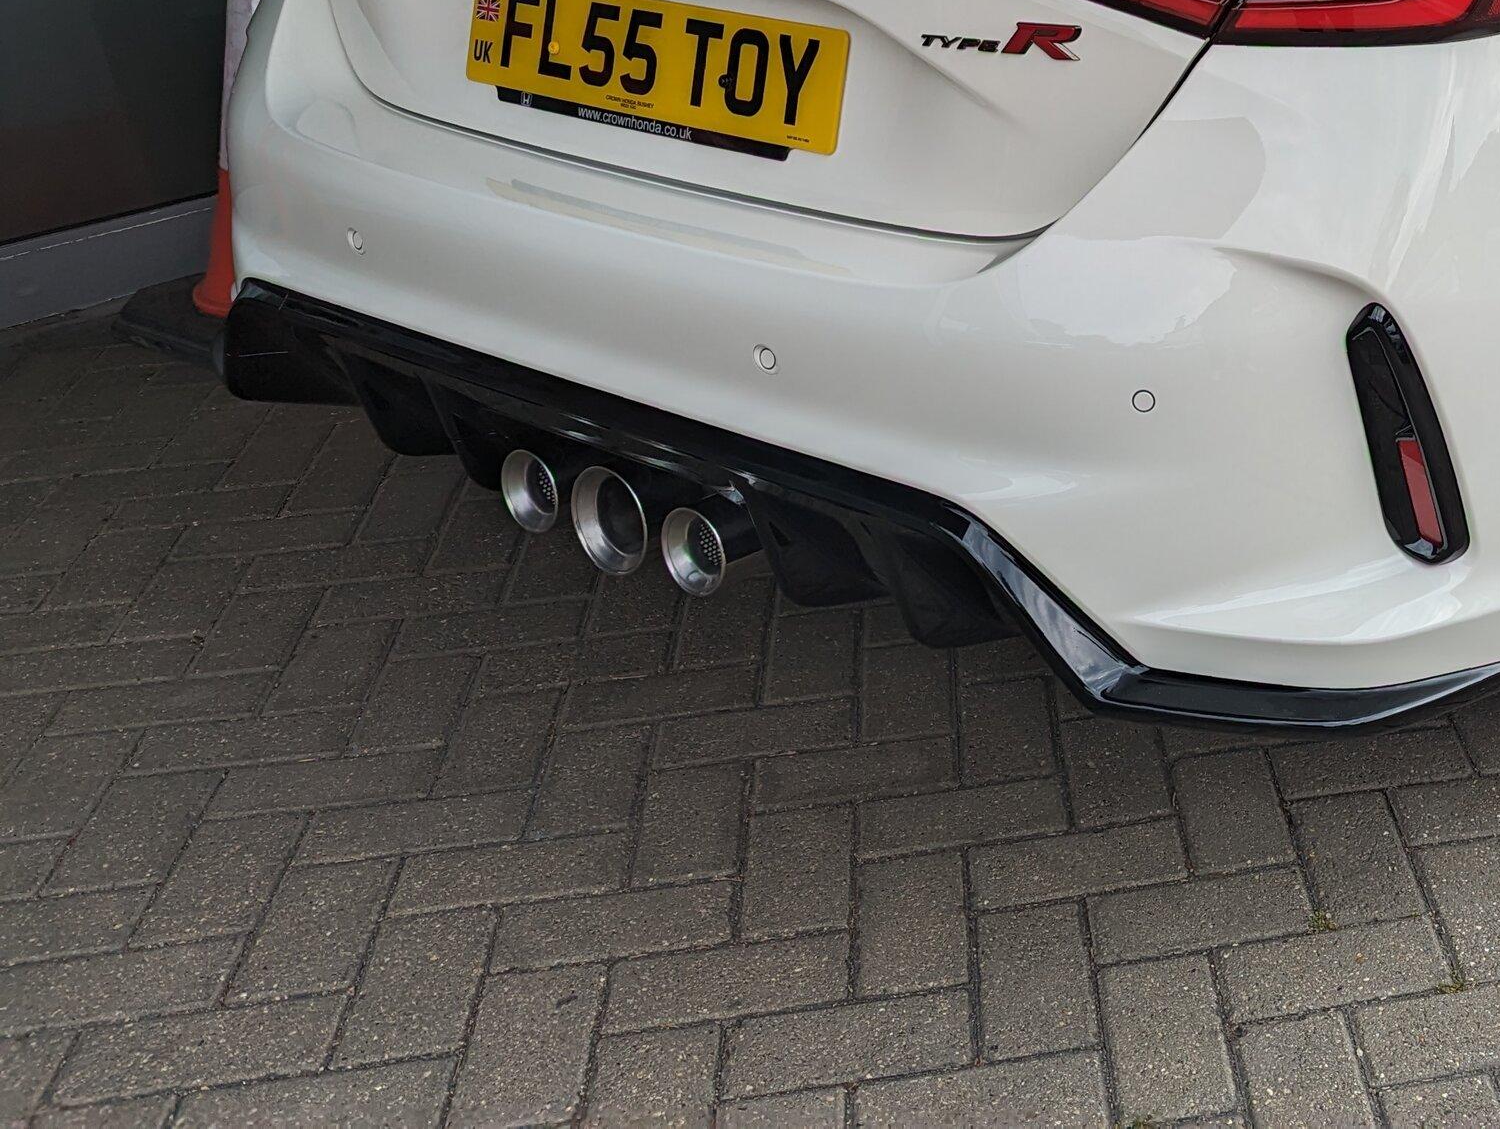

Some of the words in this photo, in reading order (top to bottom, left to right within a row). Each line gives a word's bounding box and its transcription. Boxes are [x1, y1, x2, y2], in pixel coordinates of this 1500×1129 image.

[473, 38, 494, 64] UK
[921, 34, 1001, 53] TYPE
[1001, 21, 1083, 61] R
[685, 18, 821, 126] TOY
[577, 106, 692, 141] www.crownhonda.co.uk
